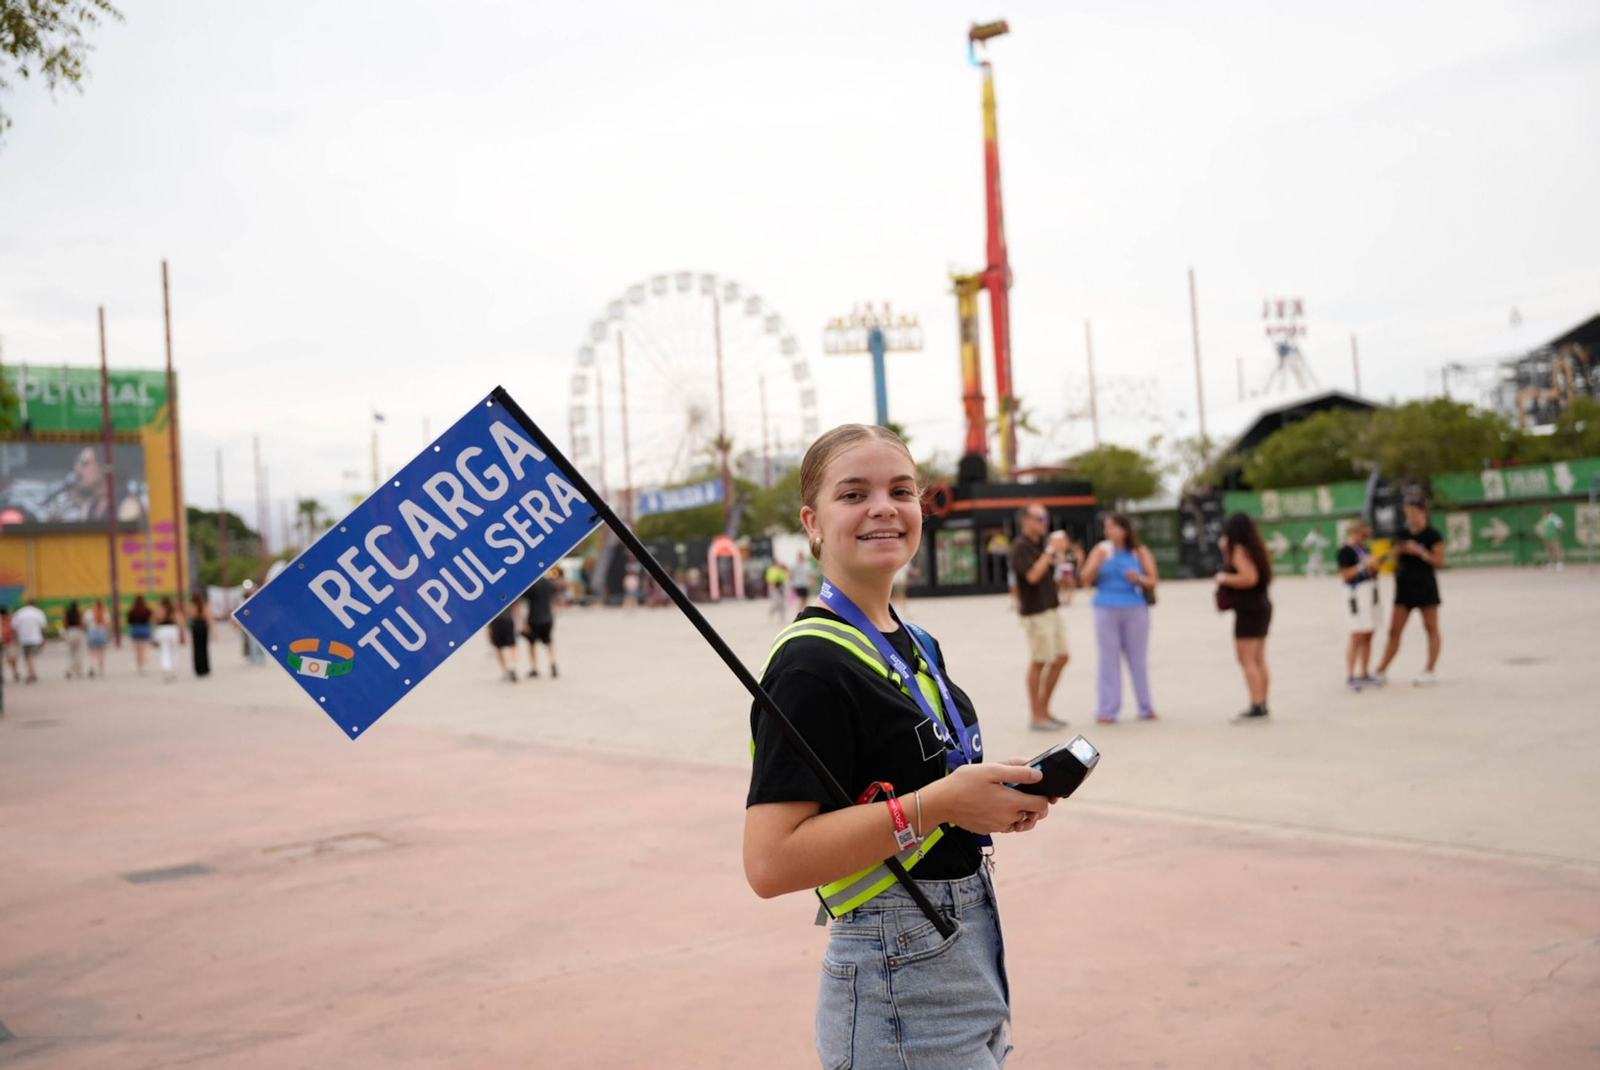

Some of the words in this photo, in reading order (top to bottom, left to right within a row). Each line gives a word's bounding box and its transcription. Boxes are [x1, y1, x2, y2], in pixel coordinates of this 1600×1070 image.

[308, 421, 546, 629] RECARGA
[358, 606, 426, 670] TU
[417, 472, 587, 624] PULSERA
